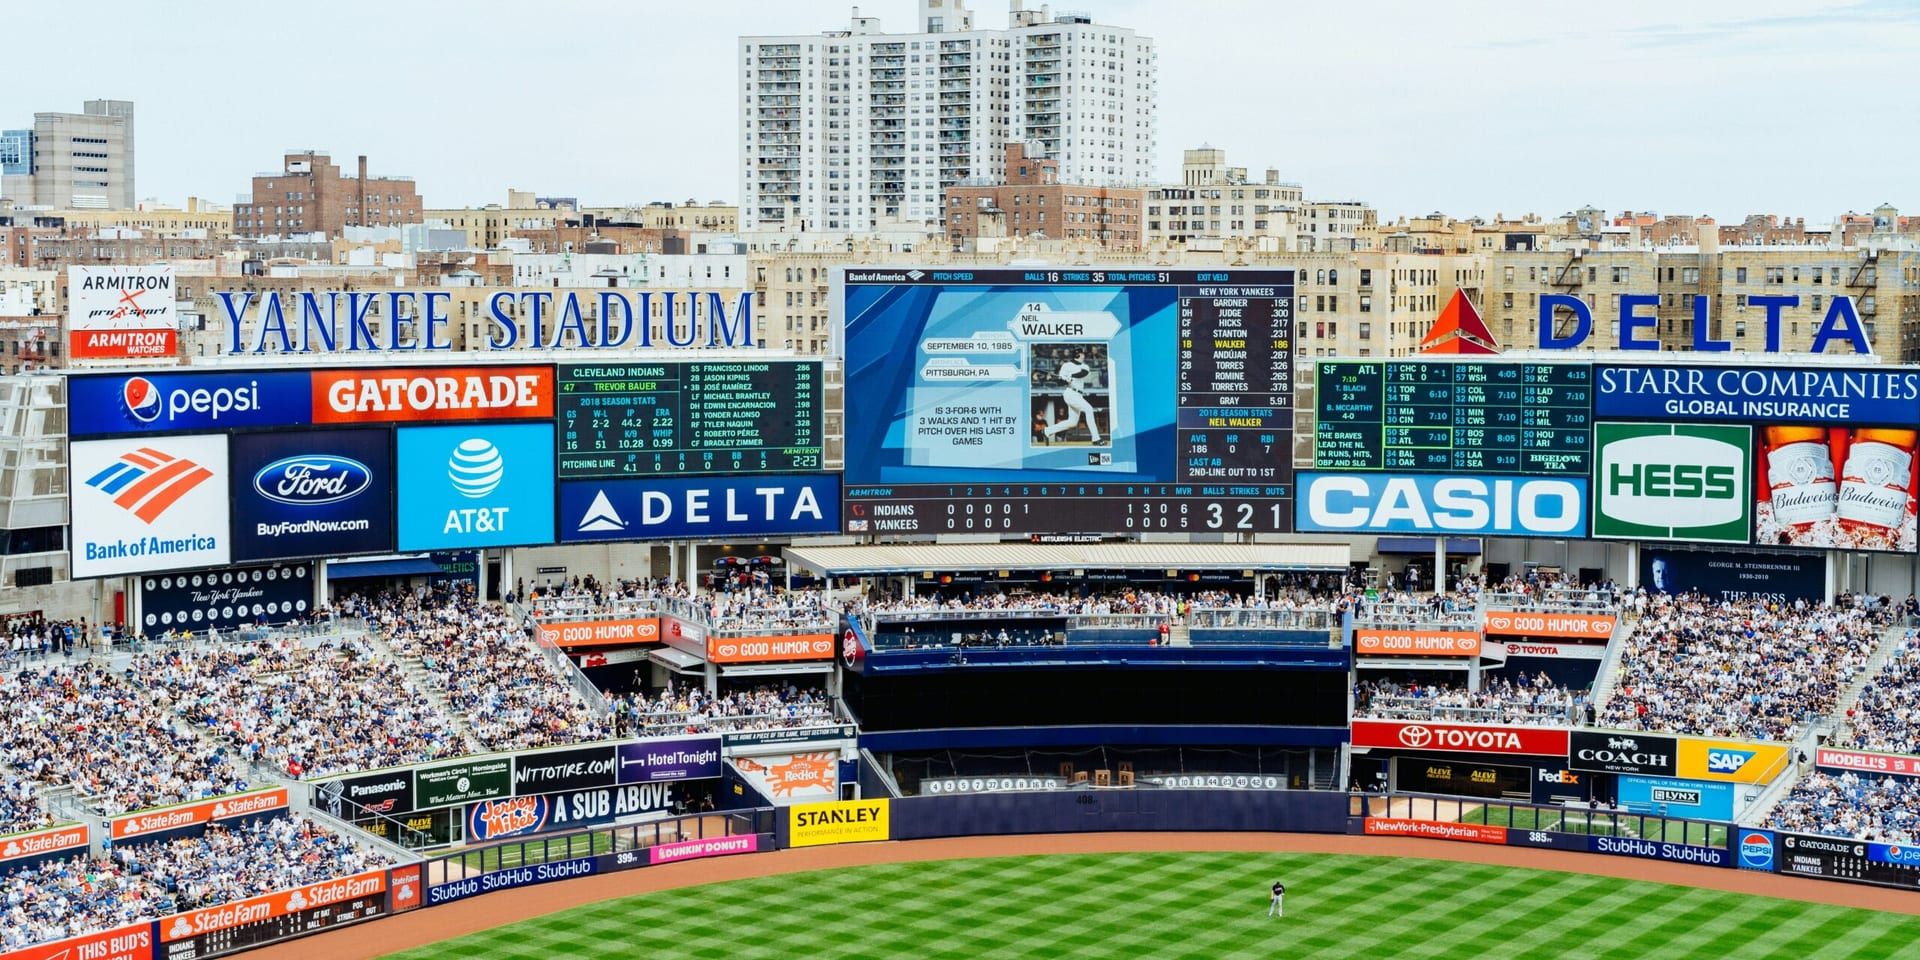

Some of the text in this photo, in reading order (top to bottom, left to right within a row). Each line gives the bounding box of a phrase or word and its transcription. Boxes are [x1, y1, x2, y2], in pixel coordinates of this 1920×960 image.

[82, 276, 169, 289] ARMITRON
[849, 272, 905, 281] Bank of America
[1047, 272, 1058, 282] 16
[1092, 273, 1104, 282] 35
[1159, 273, 1169, 282] 51
[1028, 304, 1041, 312] 14
[216, 291, 756, 354] YANKEE STADIUM
[1022, 324, 1083, 336] WALKER
[1538, 294, 1873, 354] DELTA
[88, 333, 168, 346] ARMITRON
[977, 343, 990, 351] 10,
[573, 368, 664, 377] CLEVELAND INDIANS
[926, 369, 978, 378] PITTSBURGH,
[1323, 365, 1377, 374] SF ATL
[1600, 368, 1918, 401] STARR COMPANIES
[169, 381, 258, 420] pepsi
[328, 376, 538, 412] GATORADE
[1665, 399, 1850, 418] GLOBAL INSURANCE
[793, 456, 816, 467] 2:23
[277, 462, 348, 496] Ford
[1610, 463, 1735, 500] HESS
[642, 487, 823, 525] DELTA
[1308, 476, 1581, 532] CASIO
[1841, 486, 1904, 510] Budweiser
[874, 505, 914, 516] INDIANS
[1206, 503, 1280, 529] 3 2 1
[257, 518, 369, 536] BuyFordNow.com
[443, 506, 509, 534] AT&T
[874, 519, 918, 530] YANKEES
[85, 534, 216, 560] Bank of America
[440, 562, 475, 573] THLETICS
[191, 587, 264, 605] New York Yankees
[1722, 591, 1786, 603] THE BOSS
[563, 625, 633, 641] GOOD HUMOR
[1514, 617, 1588, 633] GOOD HUMOR
[741, 641, 810, 656] GOOD HUMOR
[1383, 634, 1454, 650] GOOD HUMOR
[1522, 645, 1558, 655] TOYOTA
[1434, 729, 1522, 749] TOYOTA
[1578, 748, 1668, 767] COACH
[1709, 752, 1746, 771] SAP
[1823, 753, 1886, 769] MODELL'S
[516, 757, 615, 784] NITTOTIRE.COM
[785, 769, 818, 780] RedHot
[1427, 767, 1452, 775] ALEVE
[1471, 770, 1496, 778] ALEVE
[1538, 768, 1579, 784] FedEx
[351, 779, 406, 797] Panasonic
[1666, 792, 1695, 800] LYNX
[481, 795, 536, 821] Jersey
[554, 782, 673, 822] A SUB ABOVE
[797, 807, 880, 827] STANLEY
[1529, 832, 1547, 842] 385
[665, 839, 748, 858] DUNKIN' DONUTS
[1598, 838, 1721, 864] StubHub StubHub
[1742, 844, 1774, 856] PEPSI
[1800, 840, 1849, 853] GATORADE
[617, 853, 632, 864] 399
[1794, 856, 1820, 866] INDIANS
[1792, 864, 1822, 873] YANKEES
[431, 862, 591, 900] StubHub StubHub StubHub
[77, 931, 149, 960] THIS BUD'S
